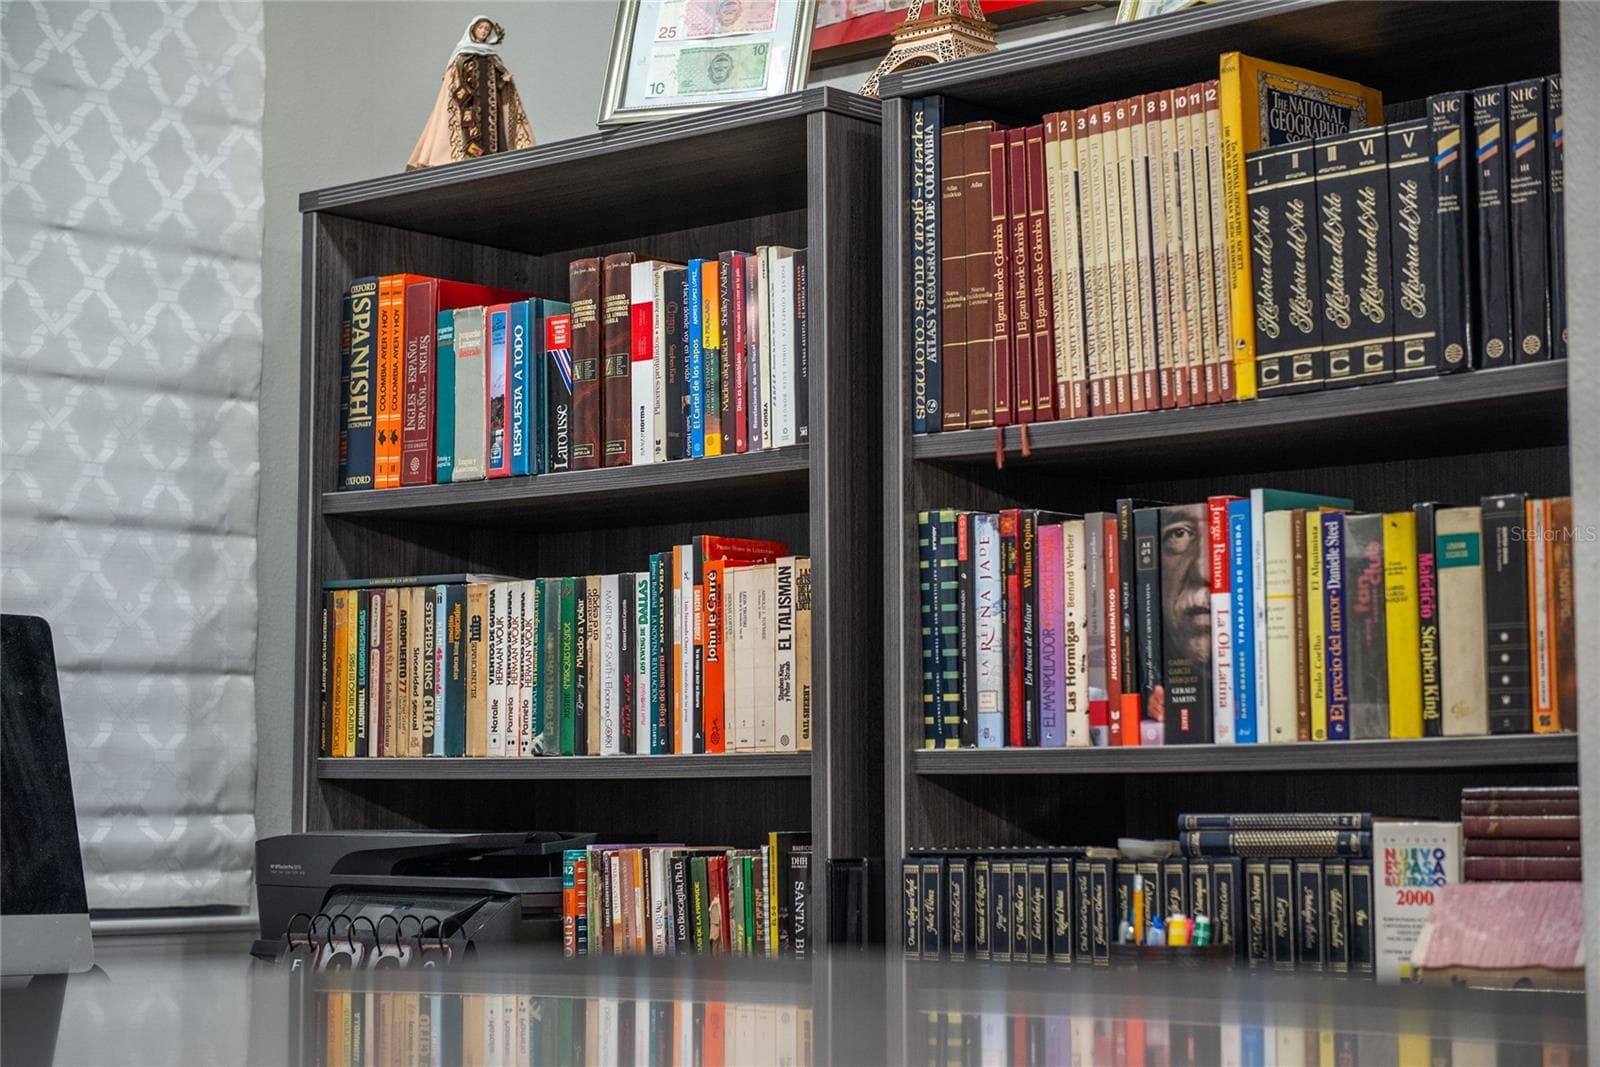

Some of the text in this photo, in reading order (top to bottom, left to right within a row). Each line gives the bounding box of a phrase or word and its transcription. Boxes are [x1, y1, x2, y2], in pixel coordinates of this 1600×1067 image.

[658, 26, 677, 39] 25
[753, 45, 766, 56] 10
[649, 82, 665, 95] 10
[1190, 93, 1200, 104] 11
[1205, 90, 1216, 101] 12
[1474, 94, 1500, 109] NHC
[1510, 87, 1537, 102] NHC
[1117, 109, 1124, 119] 6
[1147, 101, 1155, 112] 8
[1160, 100, 1167, 111] 9
[1175, 96, 1186, 109] 10
[1288, 93, 1345, 126] NATIONAL
[1433, 99, 1460, 114] NHC
[1047, 122, 1051, 133] 1
[1060, 121, 1067, 132] 2
[1078, 119, 1085, 129] 3
[1090, 115, 1097, 125] 4
[1103, 112, 1110, 123] 5
[1270, 107, 1348, 136] GEOGRAPHIC
[1359, 139, 1374, 155] VI
[1402, 132, 1415, 148] V
[1292, 153, 1299, 169] II
[1327, 146, 1337, 162] III
[1520, 164, 1530, 172] III
[1398, 180, 1418, 213] Arte
[1252, 206, 1270, 237] Arte
[1285, 199, 1304, 231] Arte
[924, 125, 937, 363] ATLAS Y GEOGRAFIA DE COLOMBIA
[993, 223, 1008, 333] El gran libro de Colombia
[1033, 219, 1048, 329] El gran libro de Colombia
[1400, 244, 1426, 318] Historia
[351, 281, 377, 295] OXFORD
[1288, 261, 1313, 333] Historia
[1256, 268, 1280, 338] Historia
[349, 296, 372, 418] SPANISH
[684, 345, 689, 354] en
[692, 338, 700, 363] sapos
[722, 338, 730, 379] alquilada
[513, 325, 523, 456] RESPUESTA A TODO
[692, 380, 699, 390] de
[692, 392, 700, 419] Cartel
[554, 404, 569, 470] Larousse
[692, 421, 700, 429] El
[345, 474, 371, 487] OXFORD
[1023, 518, 1034, 589] William Ospina
[1210, 504, 1225, 589] Jorge Ramos
[1310, 526, 1321, 591] El Alquimista
[1235, 524, 1245, 644] TRABAJOS DE MIERDA
[1354, 575, 1370, 612] fan
[638, 580, 648, 625] DALLAS
[777, 566, 792, 651] EL TALISMAN
[707, 570, 718, 663] John le Carré
[1065, 534, 1078, 713] Las Hormigas Bernard Werber
[1108, 588, 1117, 646] MATEMÁTICOS
[1216, 609, 1230, 628] La
[1325, 521, 1347, 721] El precio del amor Danielle Steel
[511, 616, 519, 645] WOUK
[525, 619, 533, 648] WOUK
[640, 627, 645, 636] DE
[1418, 553, 1439, 720] Maleficio Stephen King
[399, 610, 407, 694] AEROPUERTO 77
[424, 602, 433, 689] STEPHEN KING
[1023, 603, 1033, 686] En busca de Bolívar
[1217, 632, 1231, 657] Ola
[412, 647, 420, 696] Sinceridad
[1314, 635, 1323, 699] Paulo Coelho
[778, 664, 786, 701] Stephen King
[603, 689, 611, 717] parque
[1384, 848, 1445, 858] NUEVO
[1384, 861, 1446, 875] ESPASA
[1384, 877, 1446, 887] ILUSTRADO
[794, 880, 805, 932] SANTA
[1396, 890, 1434, 906] 2000
[678, 925, 686, 940] Leo
